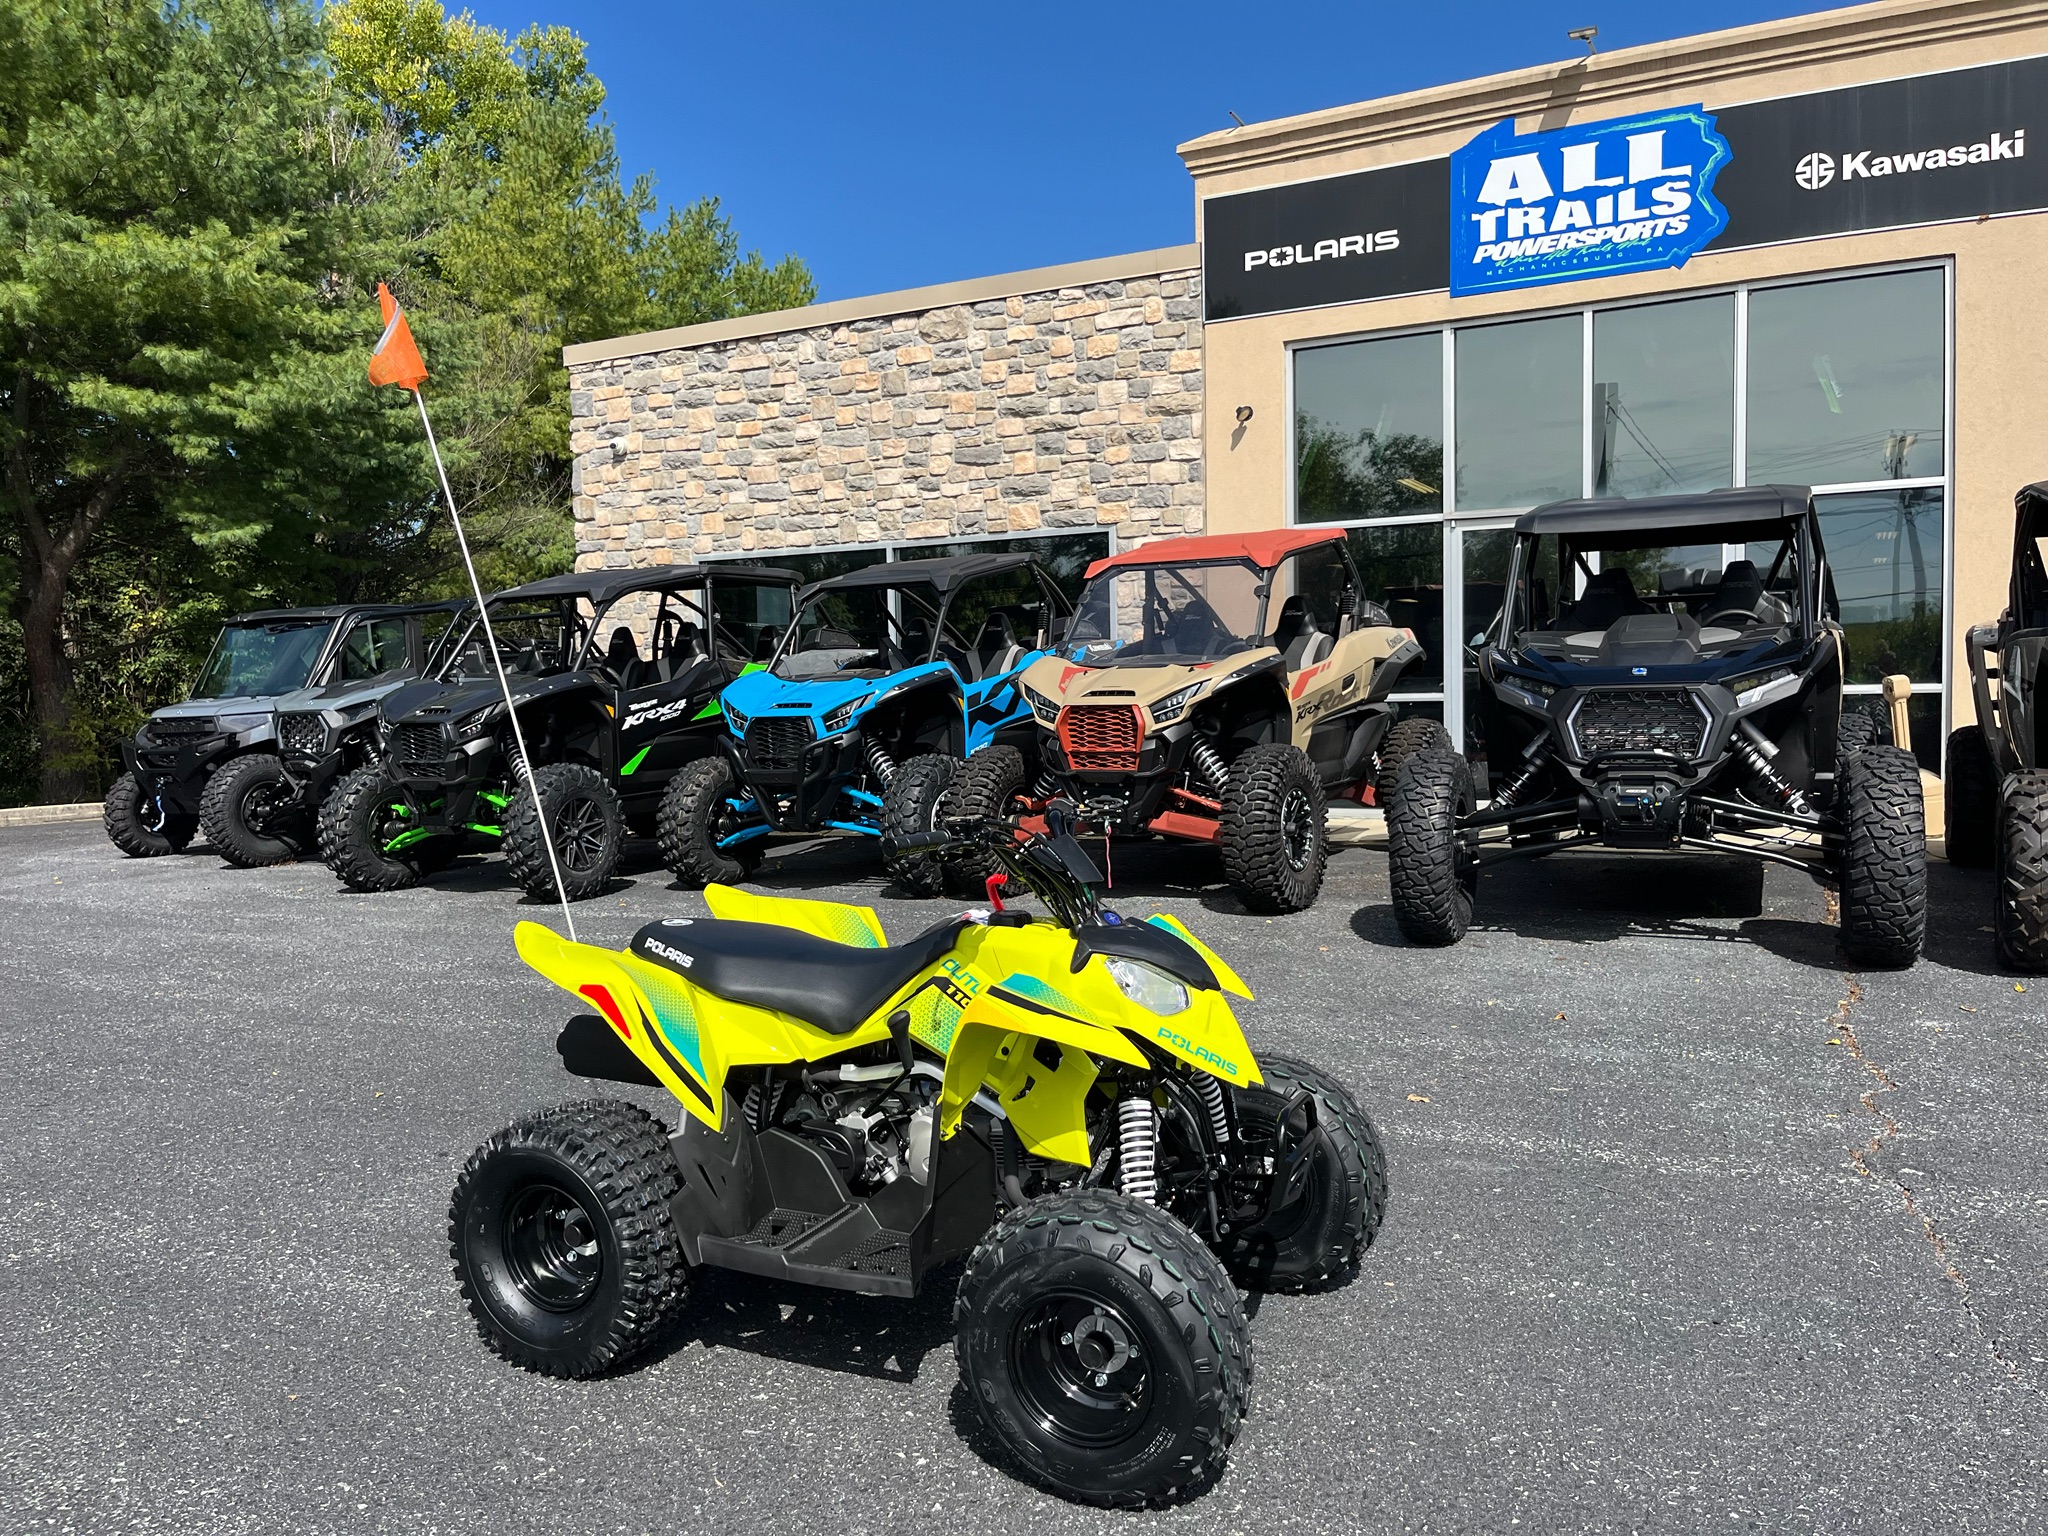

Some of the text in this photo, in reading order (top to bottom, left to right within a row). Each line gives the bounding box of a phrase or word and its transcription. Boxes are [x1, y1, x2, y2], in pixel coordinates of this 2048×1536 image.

[1477, 129, 1692, 207] ALL
[1842, 128, 2025, 181] Kawasaki
[1471, 180, 1692, 243] TRAILS
[1244, 229, 1400, 272] POLARIS
[1472, 213, 1691, 264] POWERSPORTS
[1646, 246, 1664, 254] PA
[659, 710, 682, 722] 1000
[644, 936, 695, 969] POLARIS
[942, 958, 978, 995] OUTL
[1156, 1026, 1238, 1076] POLARIS
